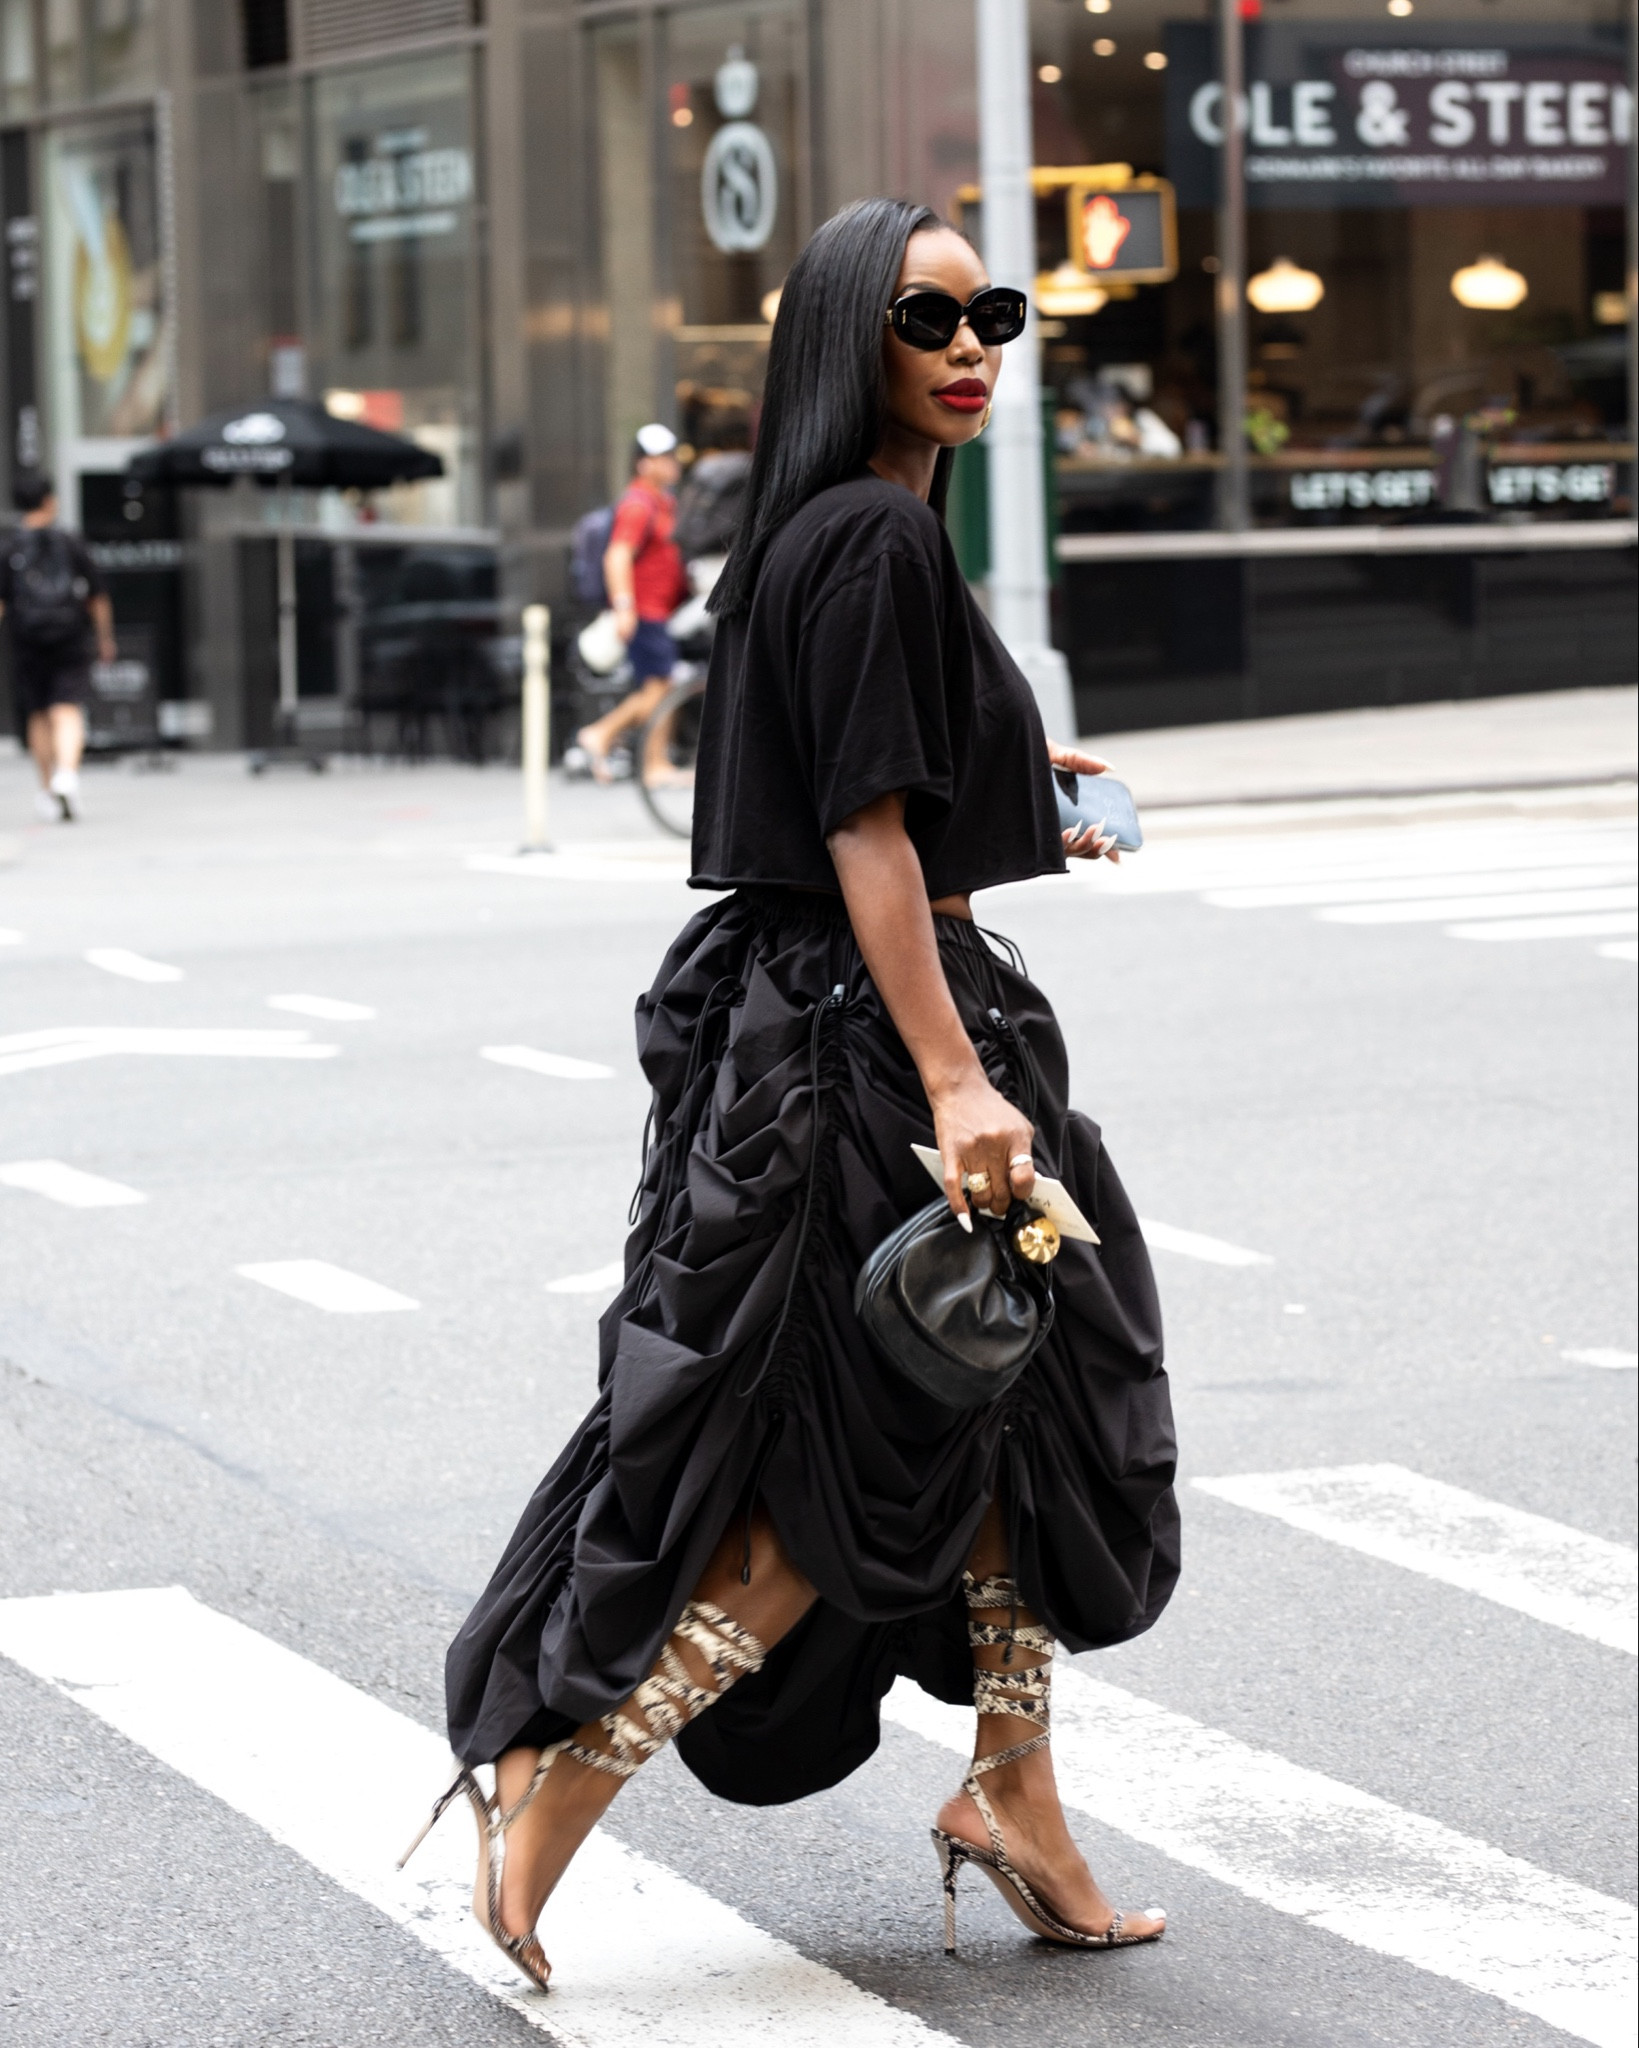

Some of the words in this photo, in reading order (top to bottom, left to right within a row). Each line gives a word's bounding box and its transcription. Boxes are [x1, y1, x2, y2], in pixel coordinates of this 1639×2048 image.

[1190, 81, 1337, 146] OLE
[1355, 81, 1410, 146] &
[1373, 471, 1432, 507] GET
